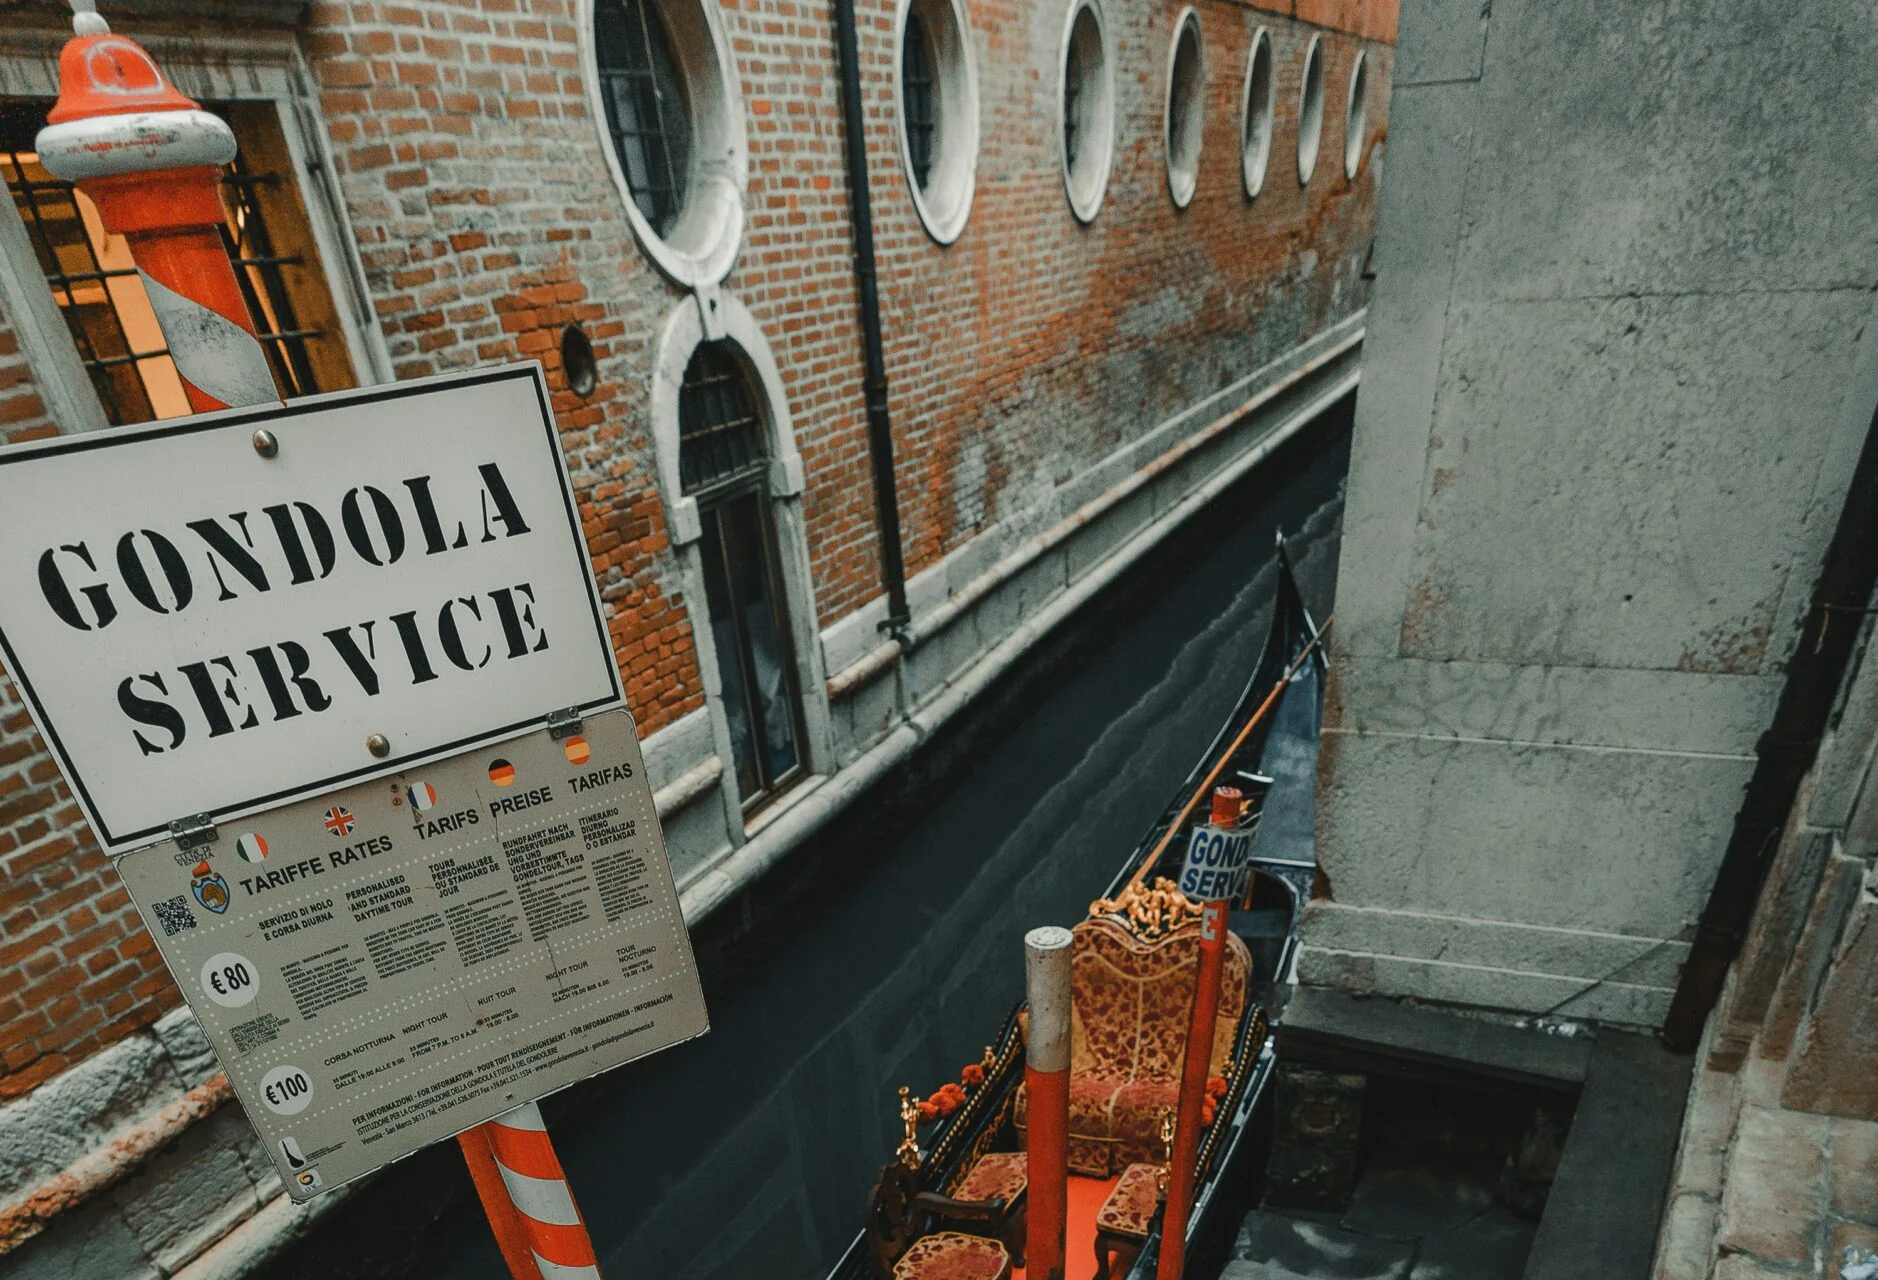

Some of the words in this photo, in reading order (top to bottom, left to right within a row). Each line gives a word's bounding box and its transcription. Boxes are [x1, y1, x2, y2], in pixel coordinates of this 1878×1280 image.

[38, 461, 532, 632] GONDOLA
[117, 583, 550, 756] SERVICE
[567, 762, 633, 794] TARIFAS
[488, 785, 554, 820] PREISE
[577, 806, 619, 827] ITINERARIO
[412, 808, 480, 841] TARIFS
[501, 828, 547, 851] RUNDFAHRT
[547, 822, 570, 837] NACH
[580, 819, 609, 835] DIURNO
[582, 819, 636, 843] PERSONALIZAD
[327, 834, 393, 869] RATES
[504, 829, 576, 859] SONDERVEREINBAR
[507, 854, 525, 867] UNG
[524, 849, 542, 861] UND
[585, 842, 592, 851] O
[592, 840, 599, 849] O
[238, 856, 326, 897] TARIFFE
[427, 857, 456, 875] TOURS
[434, 879, 447, 891] OU
[447, 866, 489, 887] STANDARD
[488, 862, 501, 873] DE
[509, 849, 568, 875] VORBESTIMMTE
[513, 860, 565, 883] GONDELTOUR,
[564, 853, 585, 867] TAGS
[344, 874, 406, 902] PERSONALISED
[350, 899, 368, 913] AND
[368, 884, 411, 906] STANDARD
[438, 884, 460, 899] JOUR
[258, 910, 299, 931] SERVIZIO
[298, 906, 310, 917] DI
[308, 898, 334, 914] NOLO
[352, 903, 391, 923] DAYTIME
[389, 895, 415, 910] TOUR
[263, 932, 272, 942] E
[271, 922, 302, 939] CORSA
[300, 911, 335, 929] DIURNA
[615, 943, 637, 957] TOUR
[618, 945, 657, 965] NOCTURNO
[544, 967, 568, 982] NIGHT
[567, 960, 589, 973] TOUR
[477, 993, 495, 1007] NUIT
[494, 986, 517, 1000] TOUR
[401, 1020, 426, 1036] NIGHT
[425, 1011, 449, 1026] TOUR
[323, 1050, 354, 1067] CORSA
[352, 1033, 397, 1056] NOTTURNA
[351, 1114, 368, 1126] PER
[365, 1093, 415, 1121] INFORMAZIONI
[416, 1086, 432, 1099] FOR
[429, 1068, 475, 1093] INFORMATION
[476, 1060, 496, 1074] POUR
[493, 1053, 511, 1067] TOUT
[569, 1025, 584, 1037] FÜR
[581, 1008, 631, 1033] INFORMATIONEN
